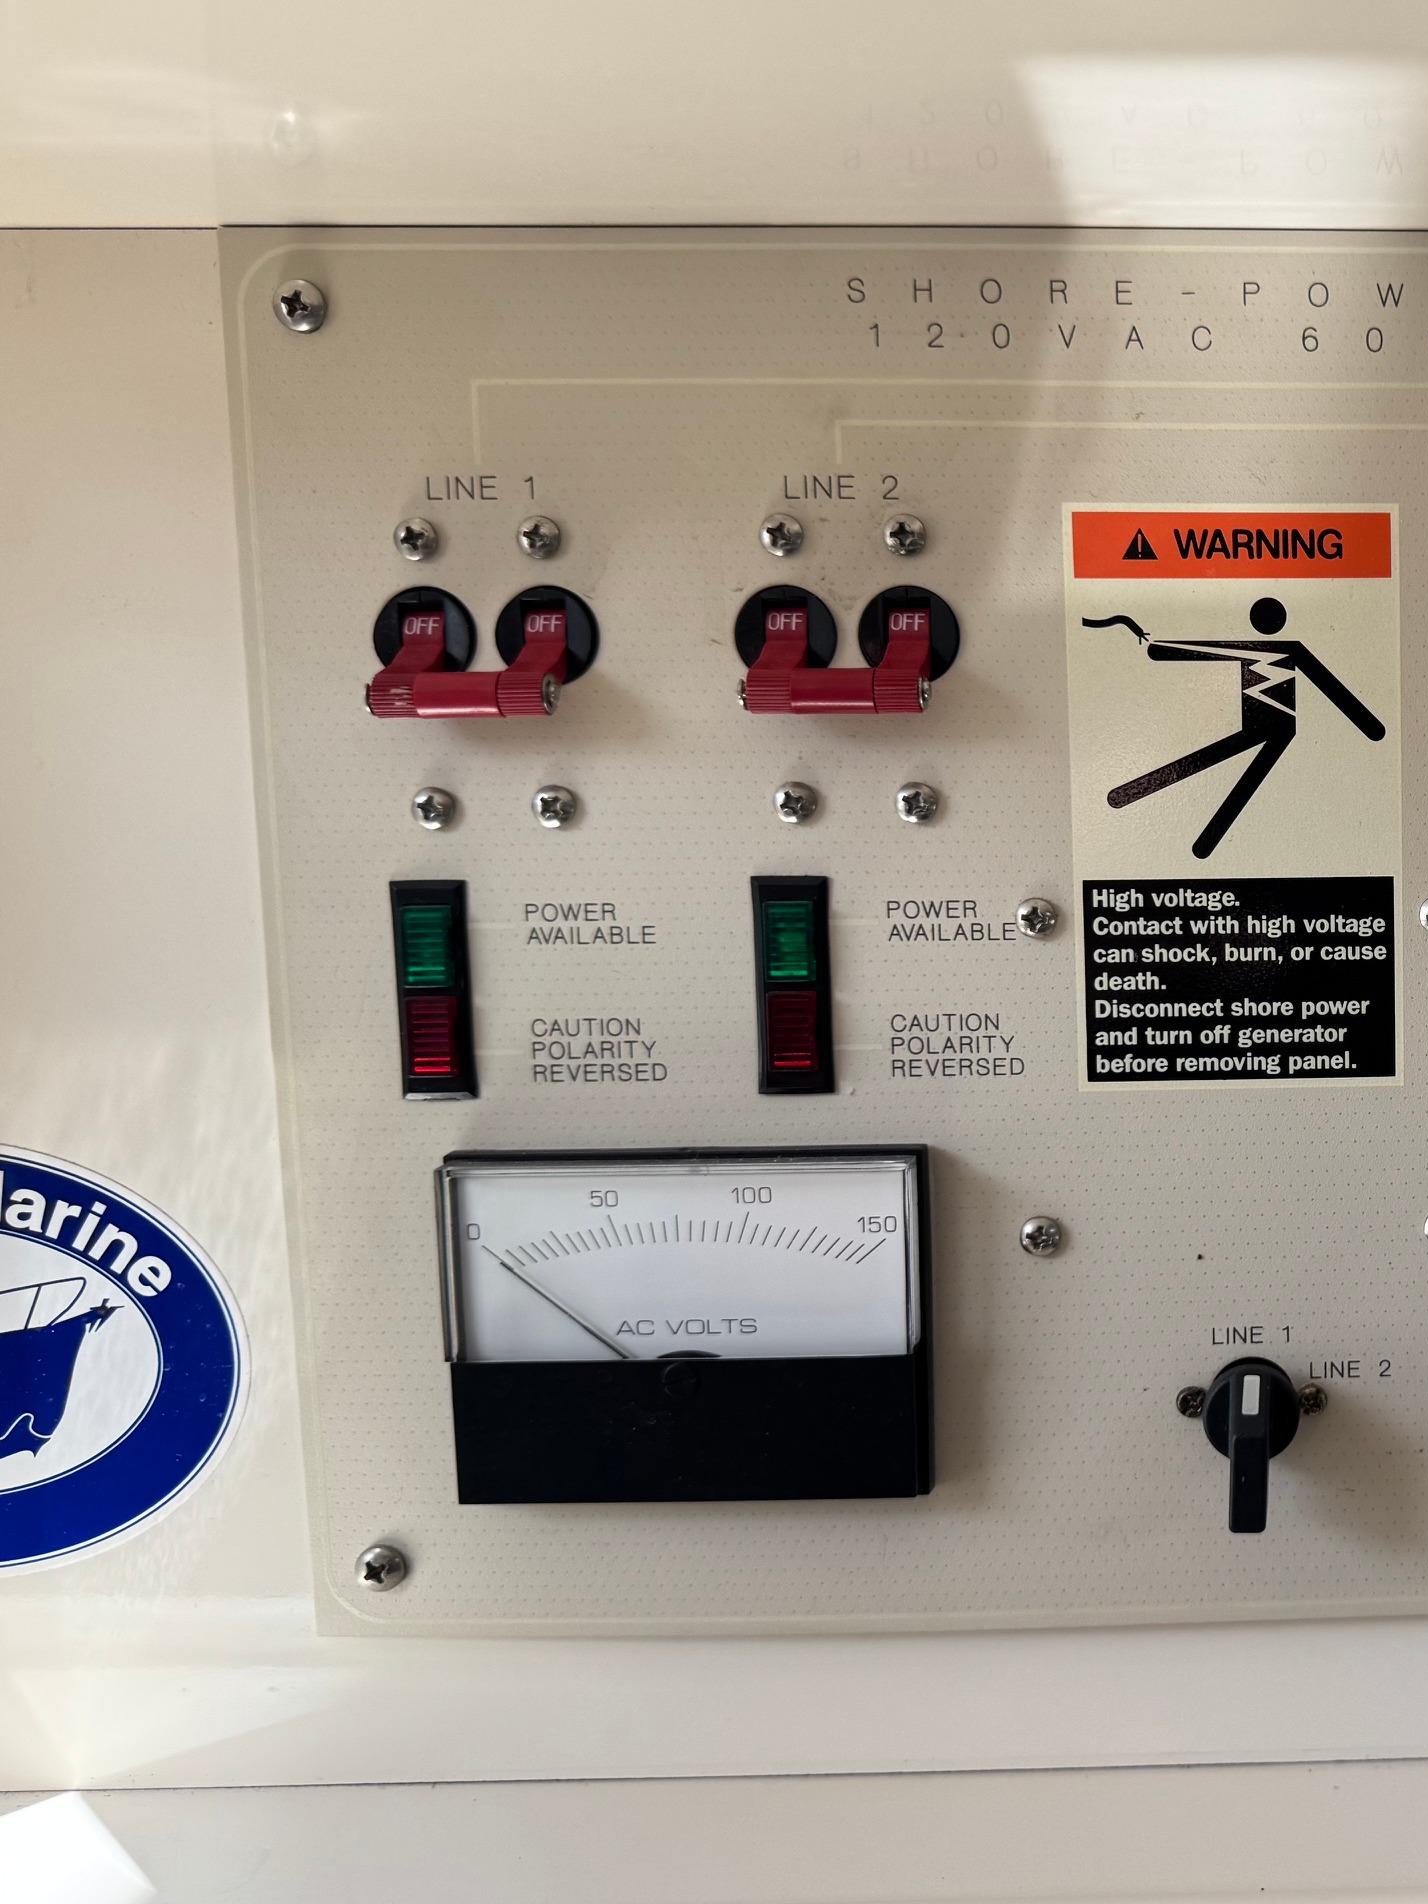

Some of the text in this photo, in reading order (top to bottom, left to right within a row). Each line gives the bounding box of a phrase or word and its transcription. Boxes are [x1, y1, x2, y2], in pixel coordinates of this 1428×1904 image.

[426, 475, 537, 501] LINE 1
[783, 474, 900, 501] LINE 2
[1173, 528, 1344, 560] WARNING
[403, 616, 441, 636] OFF
[526, 614, 562, 633] OFF
[767, 612, 803, 631] OFF
[890, 613, 926, 632] OFF
[886, 899, 978, 920] POWER
[1092, 888, 1240, 911] High voltage.
[524, 902, 617, 923] POWER
[526, 925, 657, 945] AVAILABLE
[888, 922, 1018, 942] AVAILABLE
[1092, 914, 1386, 939] Contact with high voltage
[1093, 942, 1387, 966] can shock, burn, or cause
[1094, 971, 1167, 991] death.
[1094, 997, 1370, 1020] Disconnect shore power
[531, 1017, 641, 1038] CAUTION
[890, 1012, 1000, 1033] CAUTION
[891, 1035, 1015, 1056] POLARITY
[1095, 1024, 1348, 1048] and turn off generator
[531, 1040, 657, 1061] POLARITY
[533, 1062, 668, 1083] REVERSED
[891, 1057, 1025, 1078] REVERSED
[1096, 1051, 1357, 1075] before removing panel.
[590, 1190, 619, 1208] 50
[731, 1186, 772, 1204] 100
[0, 1170, 173, 1294] arine
[466, 1222, 482, 1242] 0
[857, 1215, 898, 1233] 150
[615, 1317, 758, 1337] AC VOLTS
[1212, 1325, 1291, 1346] LINE 1
[1309, 1359, 1392, 1379] LINE 2
